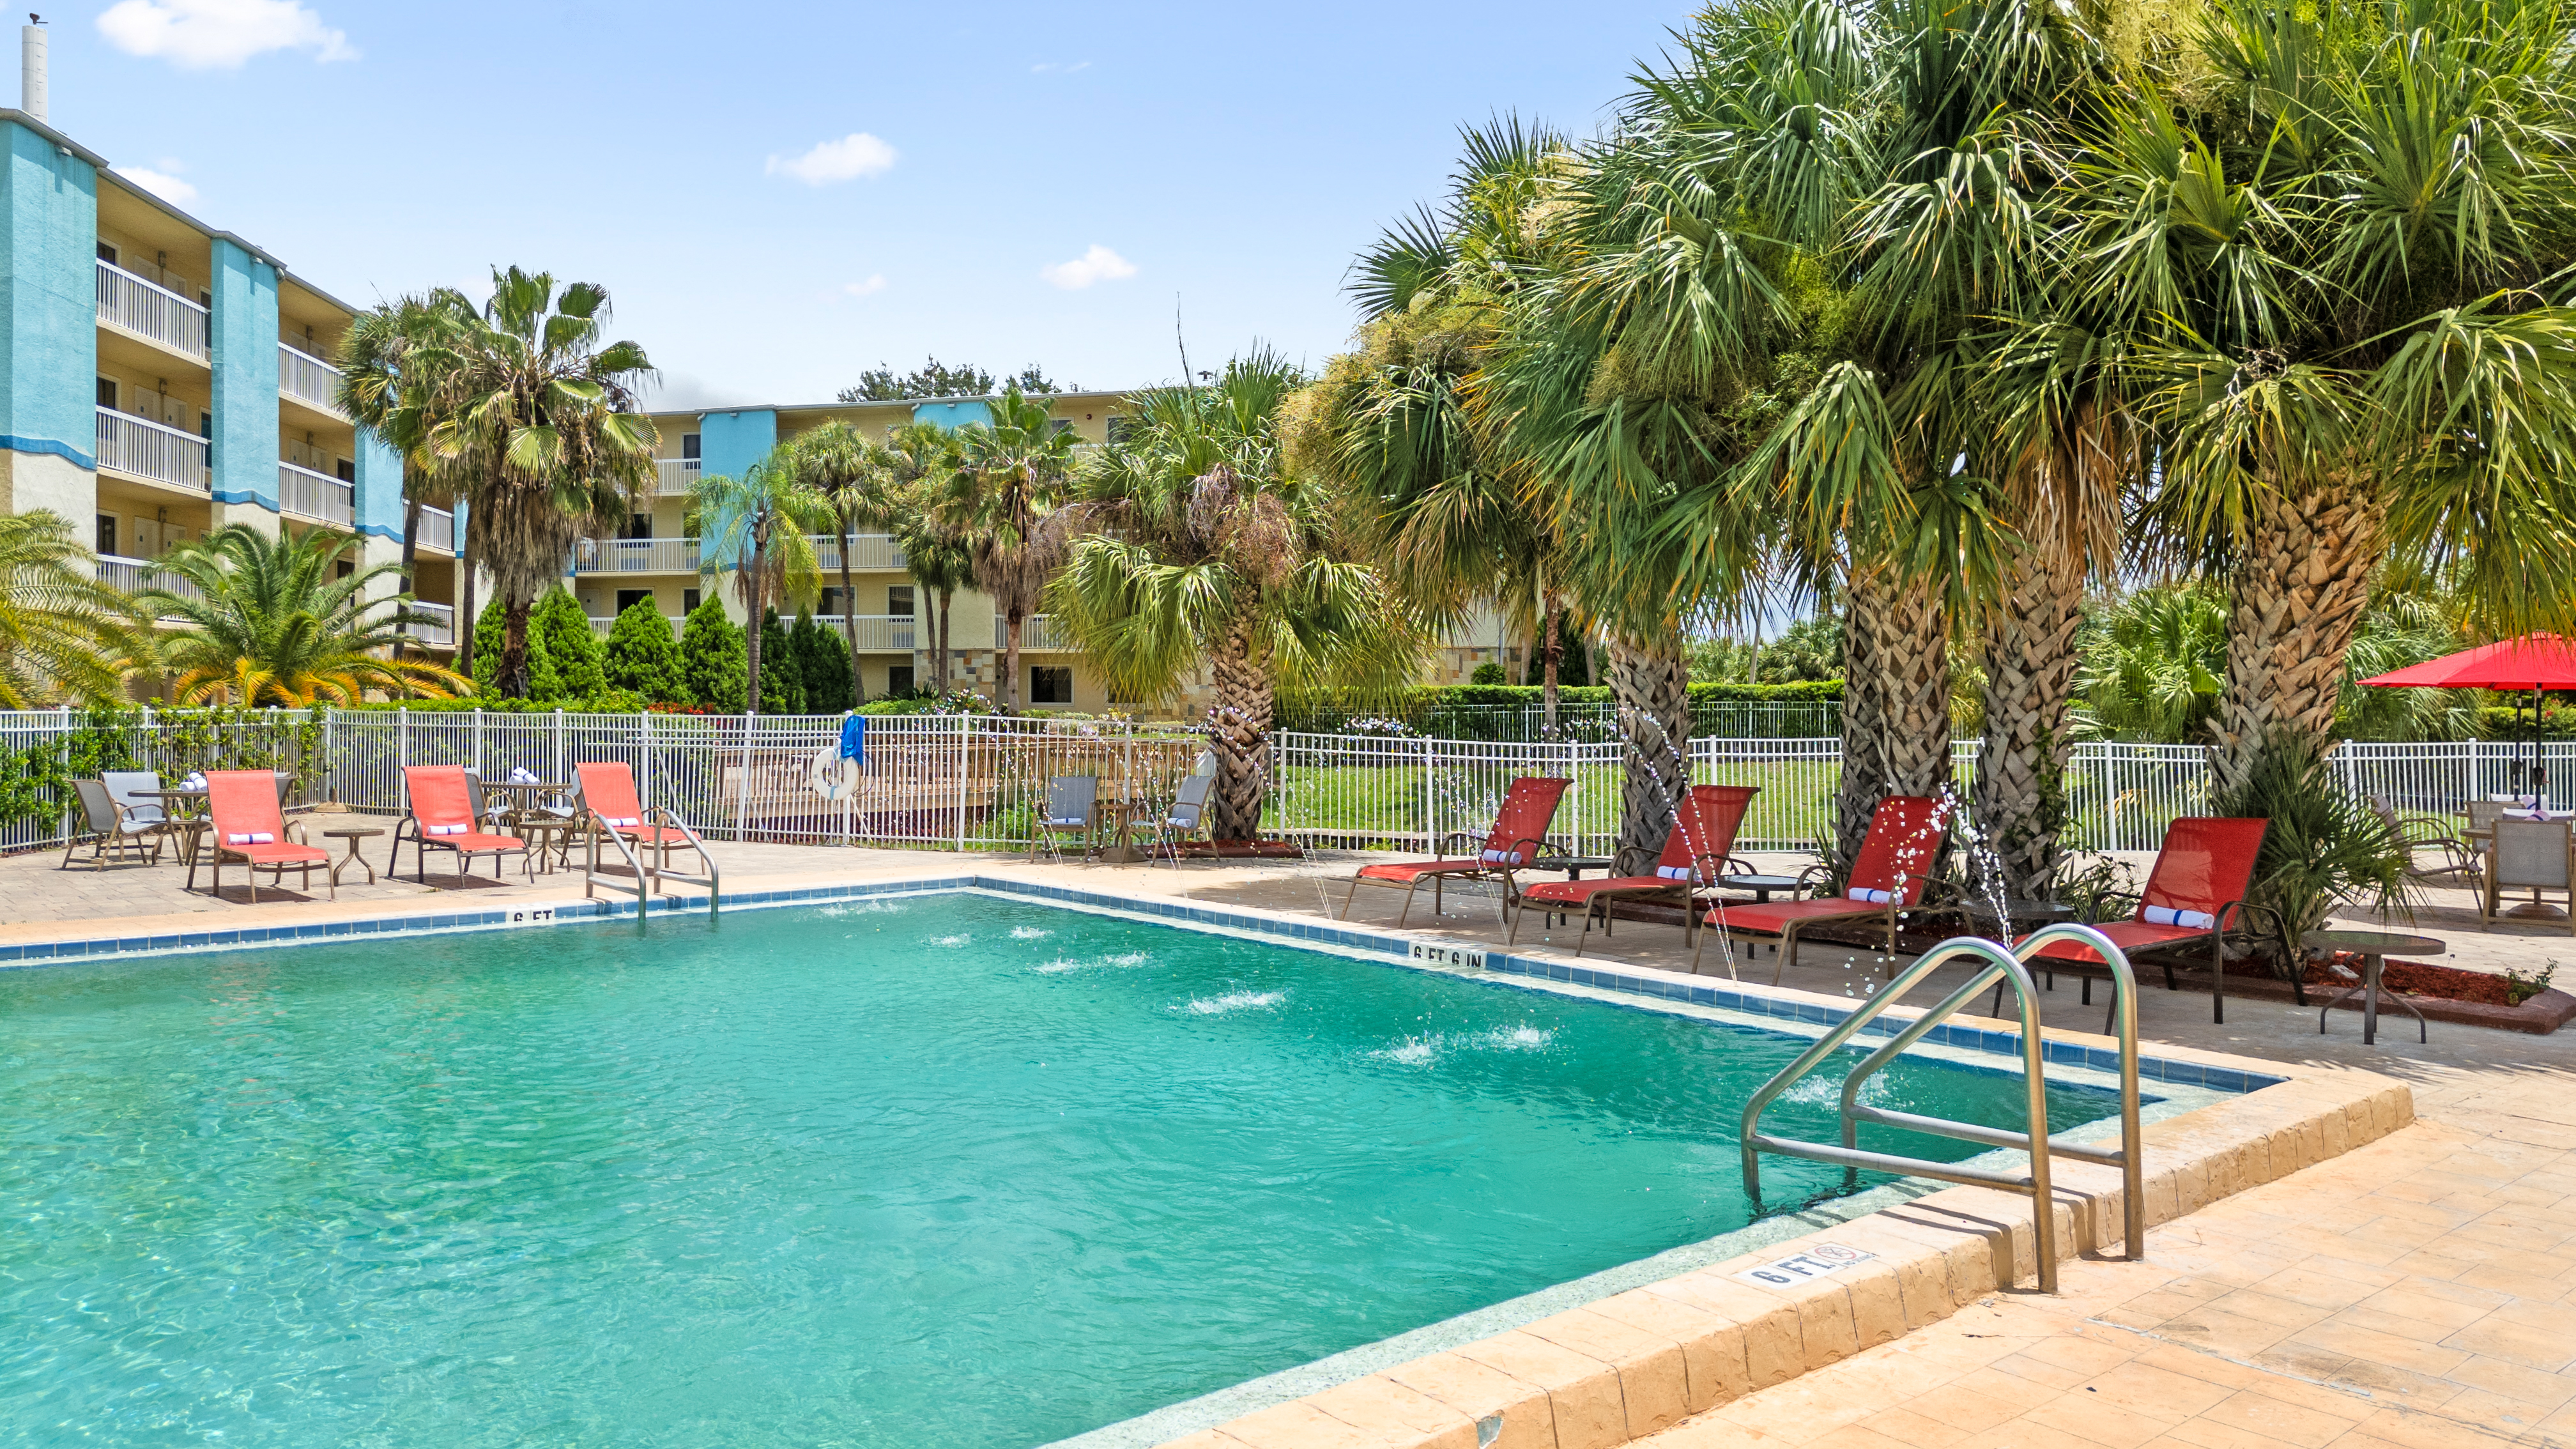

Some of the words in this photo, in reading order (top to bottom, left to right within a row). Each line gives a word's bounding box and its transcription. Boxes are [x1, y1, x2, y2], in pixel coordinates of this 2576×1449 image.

[514, 912, 523, 921] 6
[533, 910, 552, 920] FT
[1414, 946, 1422, 958] 6
[1429, 947, 1445, 961] FT
[1452, 951, 1460, 965] 6
[1466, 953, 1481, 967] IN
[1751, 1271, 1791, 1284] 6
